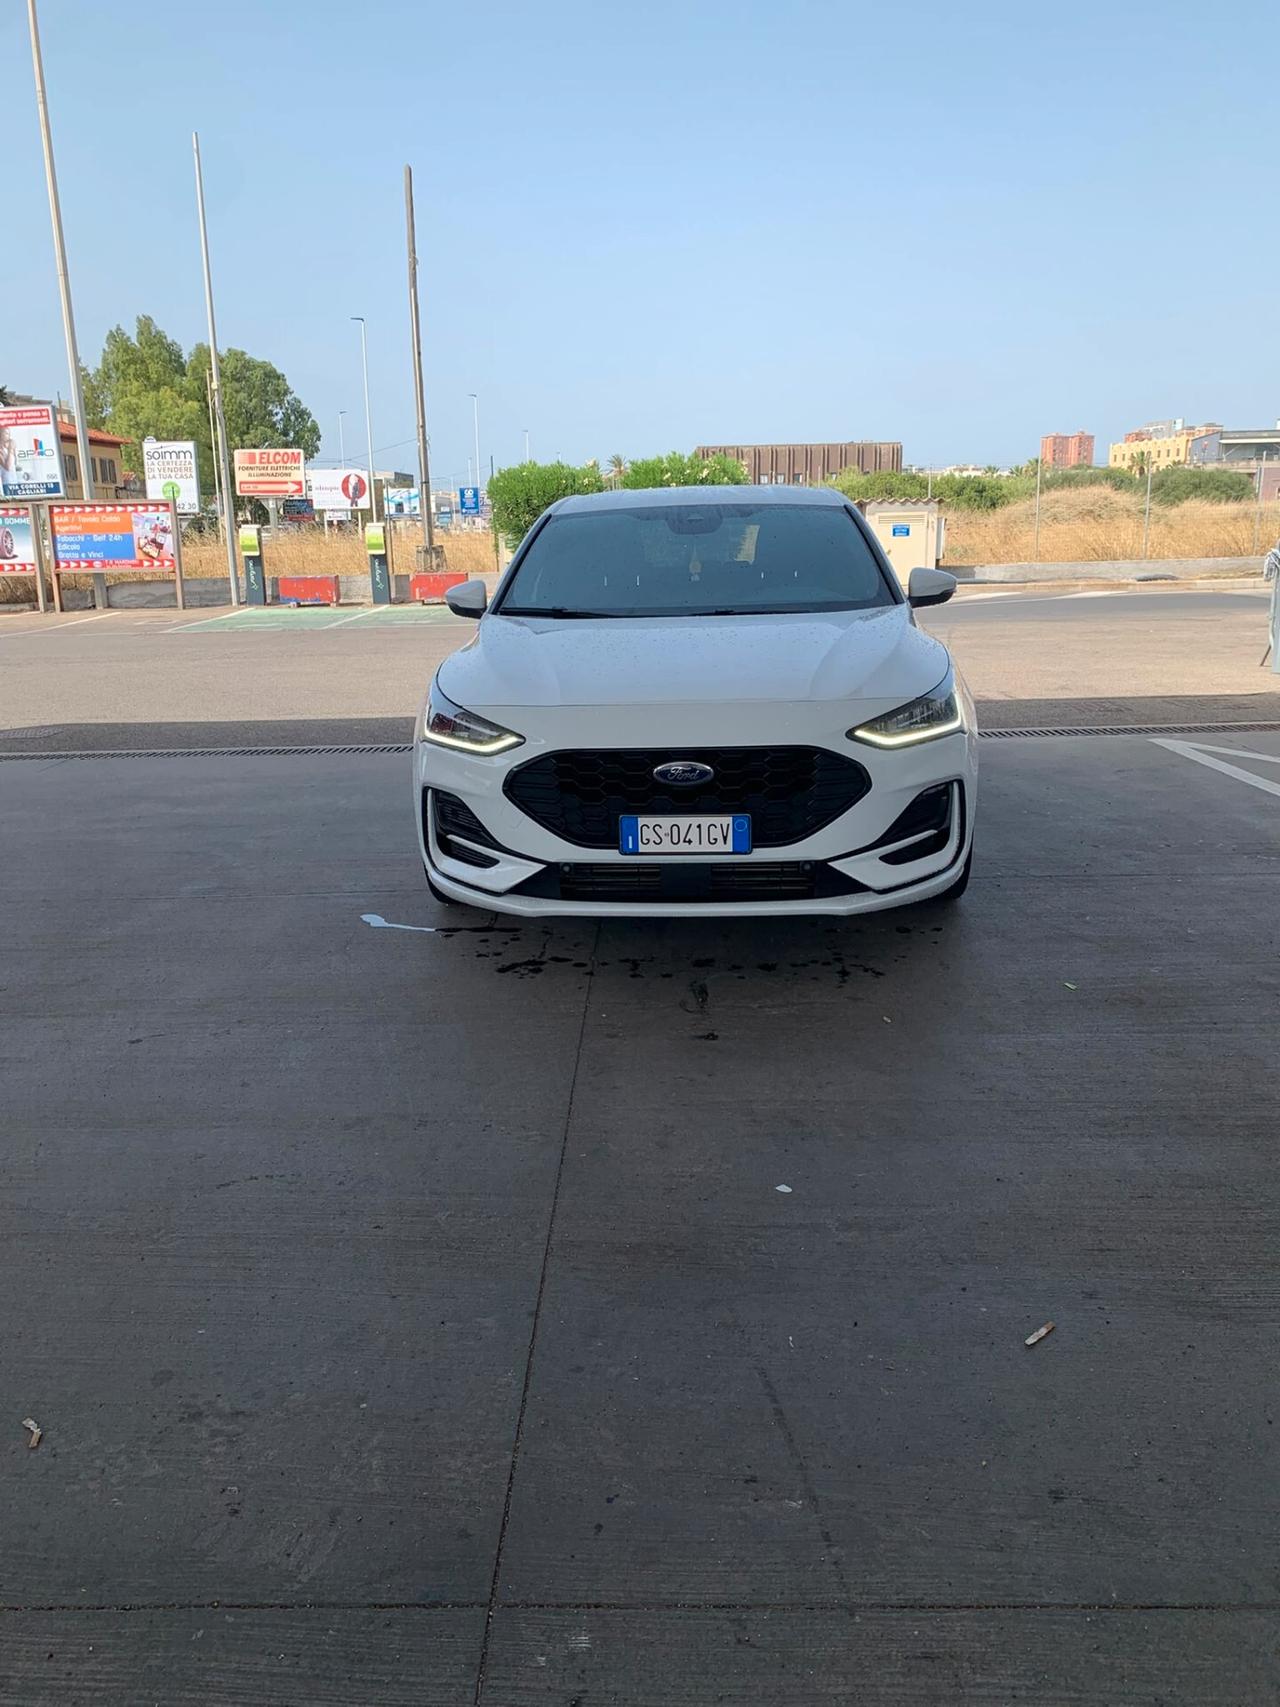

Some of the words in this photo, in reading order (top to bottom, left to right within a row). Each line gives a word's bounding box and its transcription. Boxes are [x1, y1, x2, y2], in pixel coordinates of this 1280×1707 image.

[259, 452, 301, 464] ELCOM
[108, 534, 123, 542] 24h
[667, 766, 700, 781] Ford
